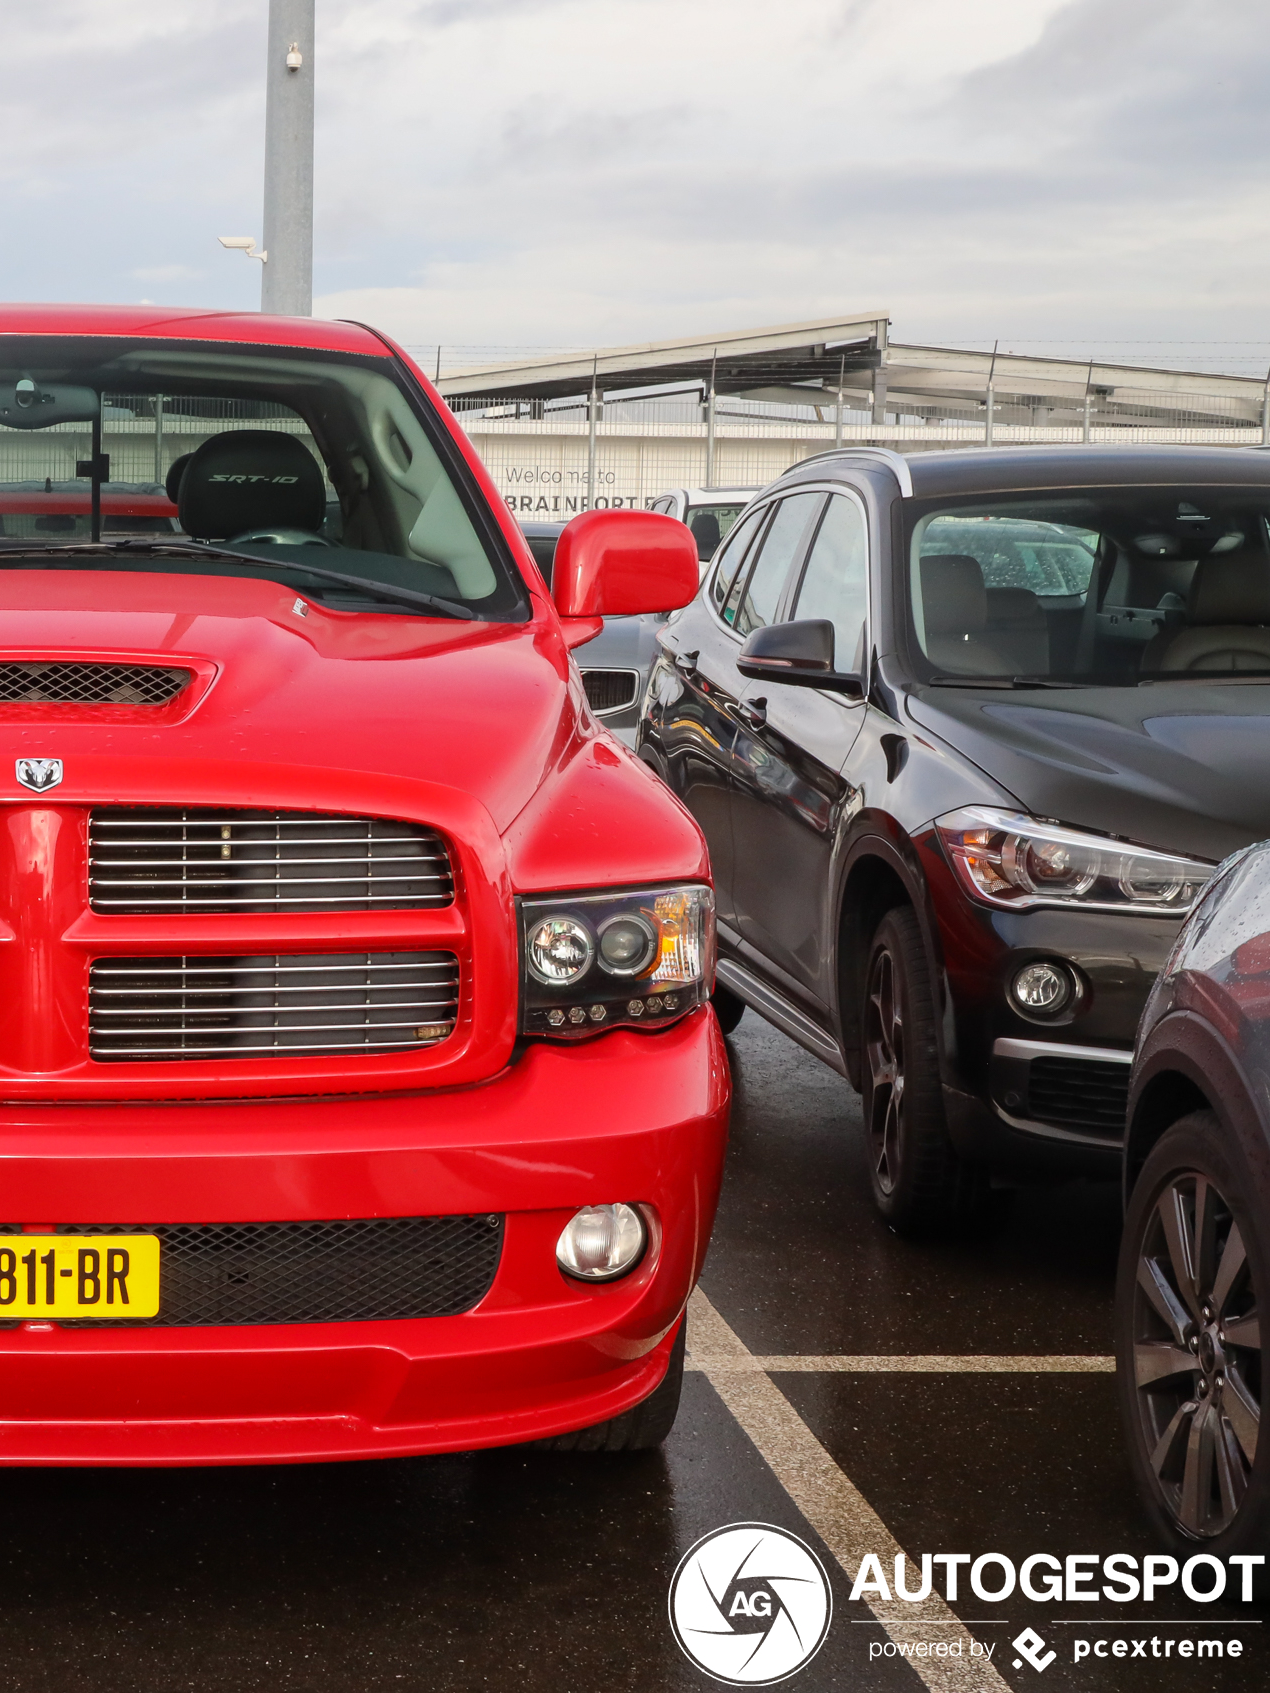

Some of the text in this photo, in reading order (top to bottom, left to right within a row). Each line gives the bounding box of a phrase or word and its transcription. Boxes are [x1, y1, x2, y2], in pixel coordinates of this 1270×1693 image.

[208, 474, 299, 484] SRT-10
[505, 465, 616, 484] Welcome to
